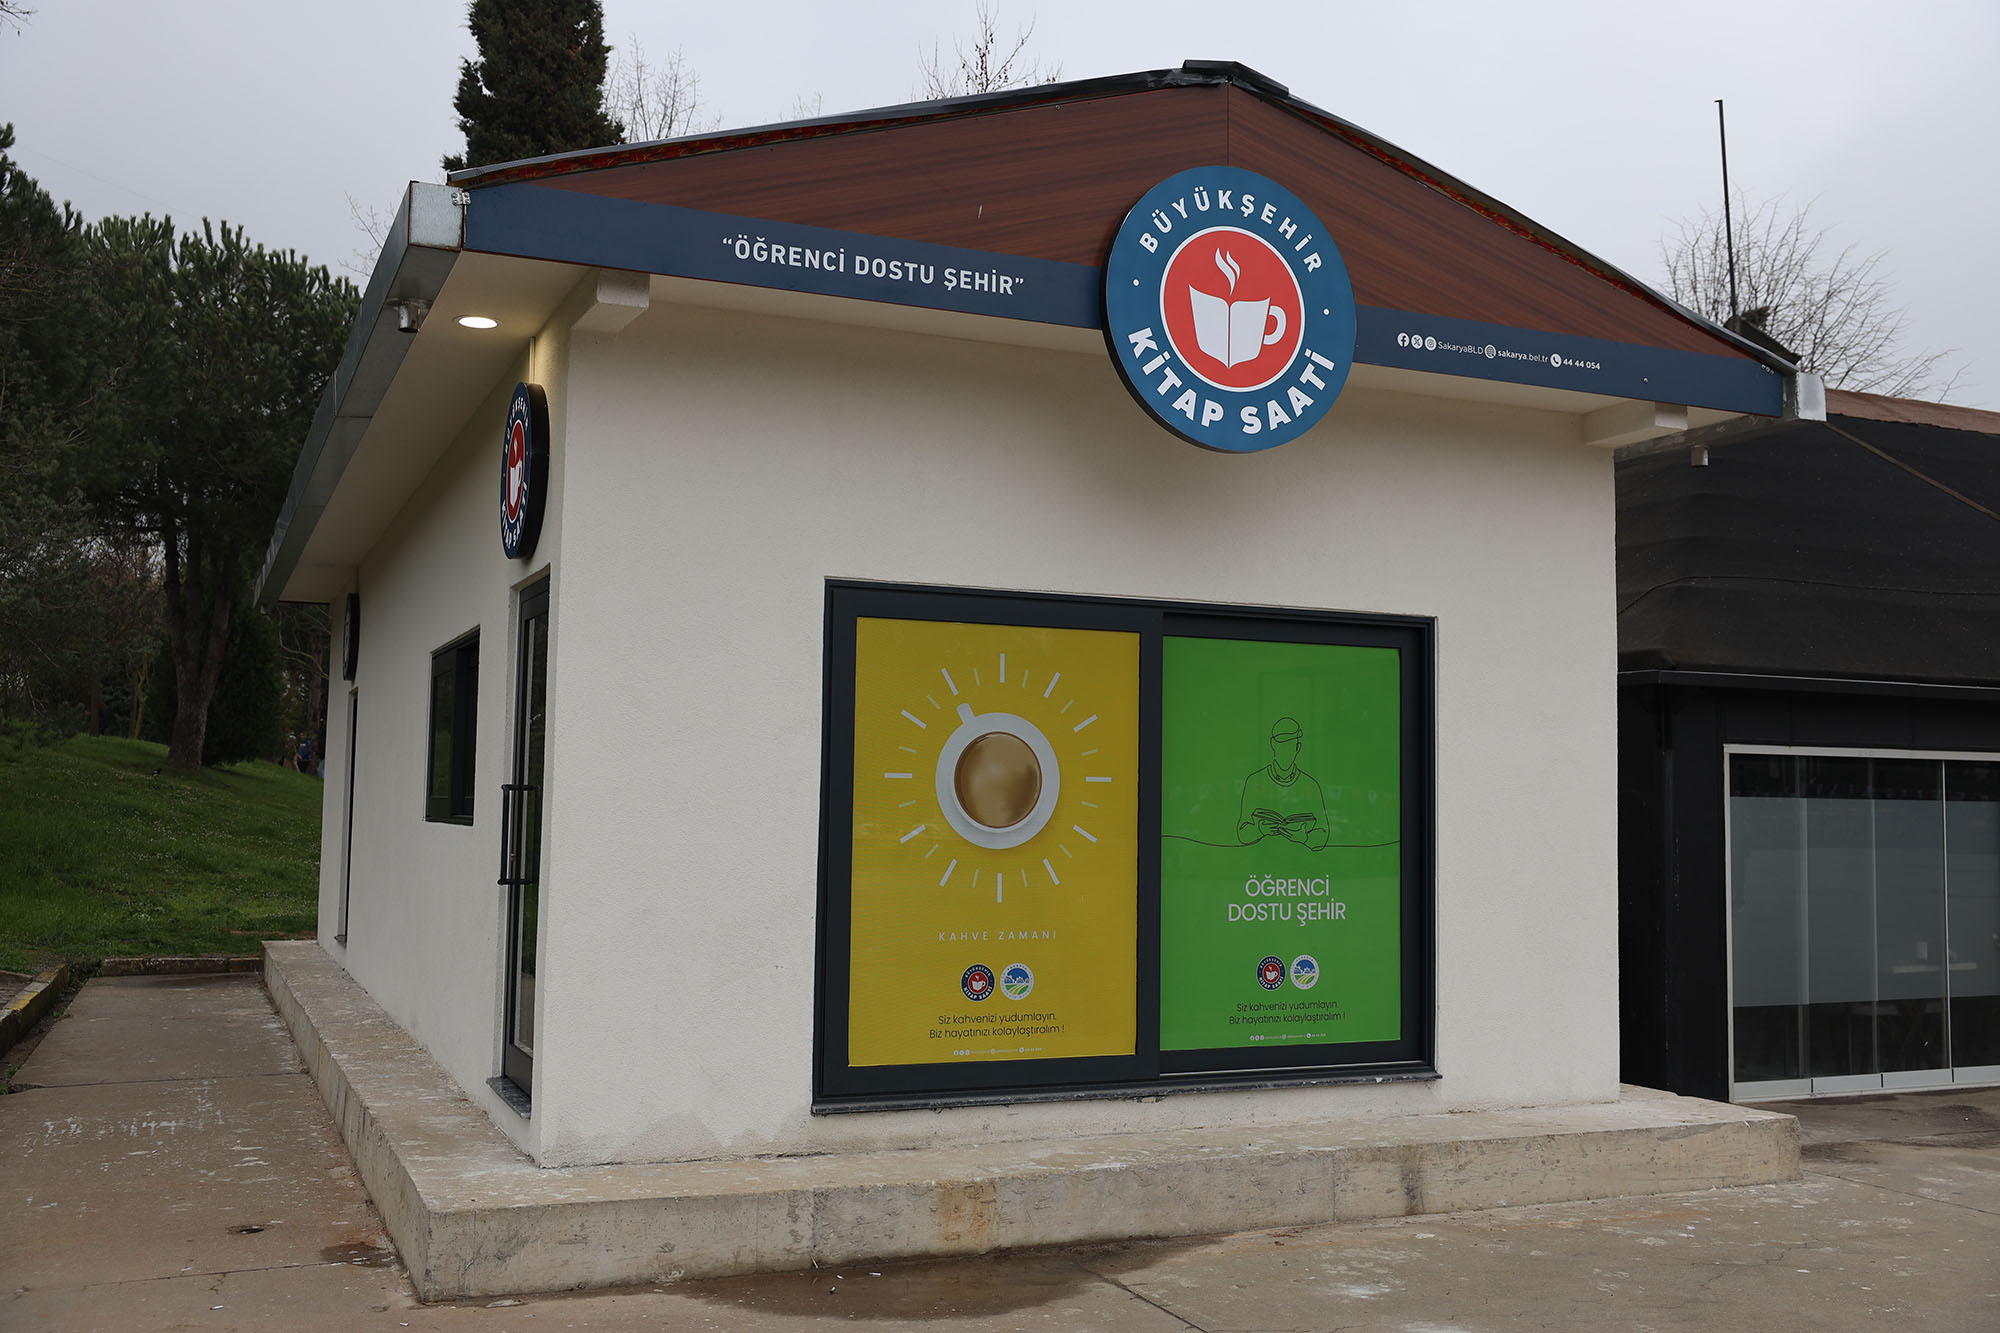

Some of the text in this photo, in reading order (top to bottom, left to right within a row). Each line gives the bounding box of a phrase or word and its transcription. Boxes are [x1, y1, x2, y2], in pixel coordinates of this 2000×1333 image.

[1139, 186, 1323, 273] BÜYÜKŞEHİR
[722, 233, 1025, 295] “ÖĞRENCİ DOSTU ŞEHİR”
[1438, 341, 1601, 370] SakaryaBLD sakarya.bel.tr 44 44 054
[1128, 327, 1335, 434] KİTAP SAATİ
[1245, 874, 1330, 897] ÖĞRENCİ
[1228, 898, 1347, 927] DOSTU ŞEHİR
[938, 930, 1057, 941] KAHVE ZAMANI
[938, 1011, 1057, 1025] Siz kahvenizi yudumlayın.
[1236, 1002, 1248, 1012] Siz
[1249, 1001, 1288, 1012] kahvenizi
[1229, 1015, 1241, 1025] Biz
[1242, 1013, 1282, 1026] hayatınızı
[1283, 1011, 1341, 1024] kolaylaştıralım
[929, 1028, 942, 1039] Biz
[944, 1026, 991, 1040] hayatınızı
[992, 1023, 1060, 1038] kolaylaştıralım
